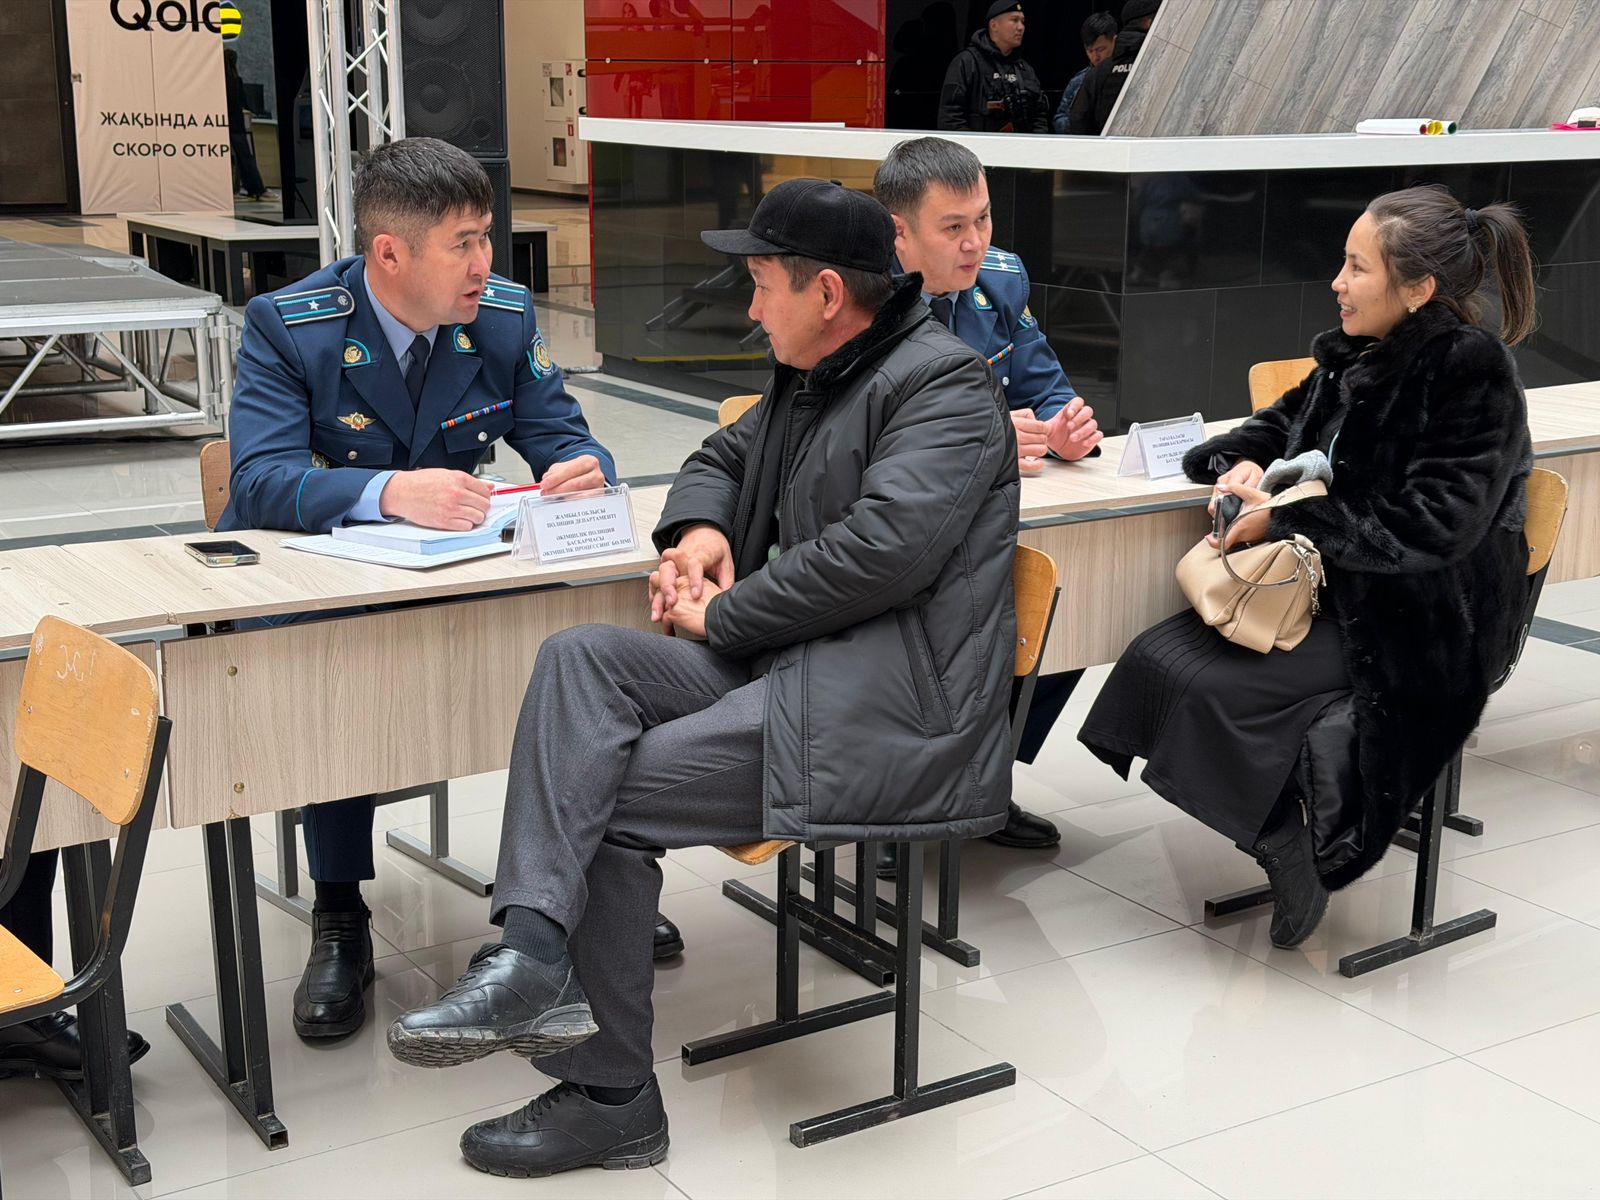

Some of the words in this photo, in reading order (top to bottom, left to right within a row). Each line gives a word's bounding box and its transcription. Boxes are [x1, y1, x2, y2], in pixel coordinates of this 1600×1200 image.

[100, 111, 198, 130] ЖАҚЫНДА
[112, 142, 177, 158] СКОРО
[182, 143, 230, 158] ОТКР
